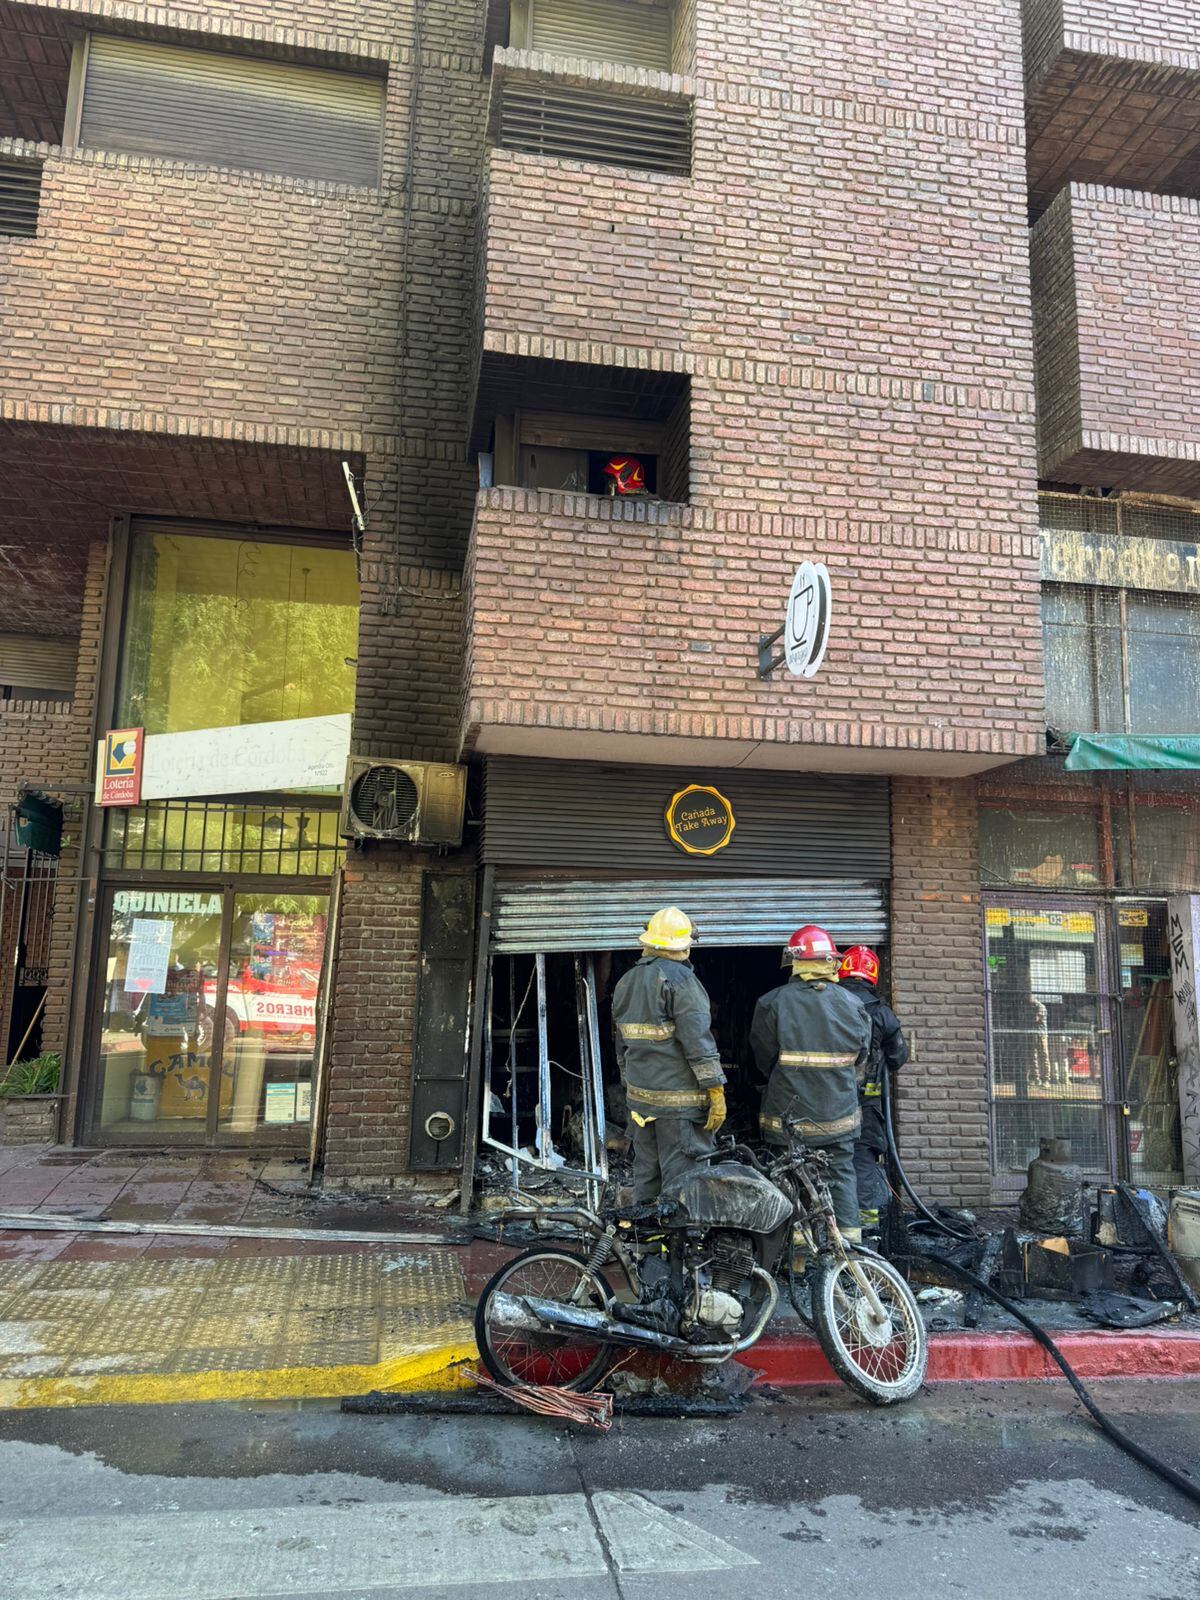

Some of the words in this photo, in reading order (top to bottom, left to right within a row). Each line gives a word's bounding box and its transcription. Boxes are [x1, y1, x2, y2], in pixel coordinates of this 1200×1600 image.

[675, 820, 699, 832] Take
[700, 815, 728, 829] Away
[113, 890, 223, 914] QUINIELA
